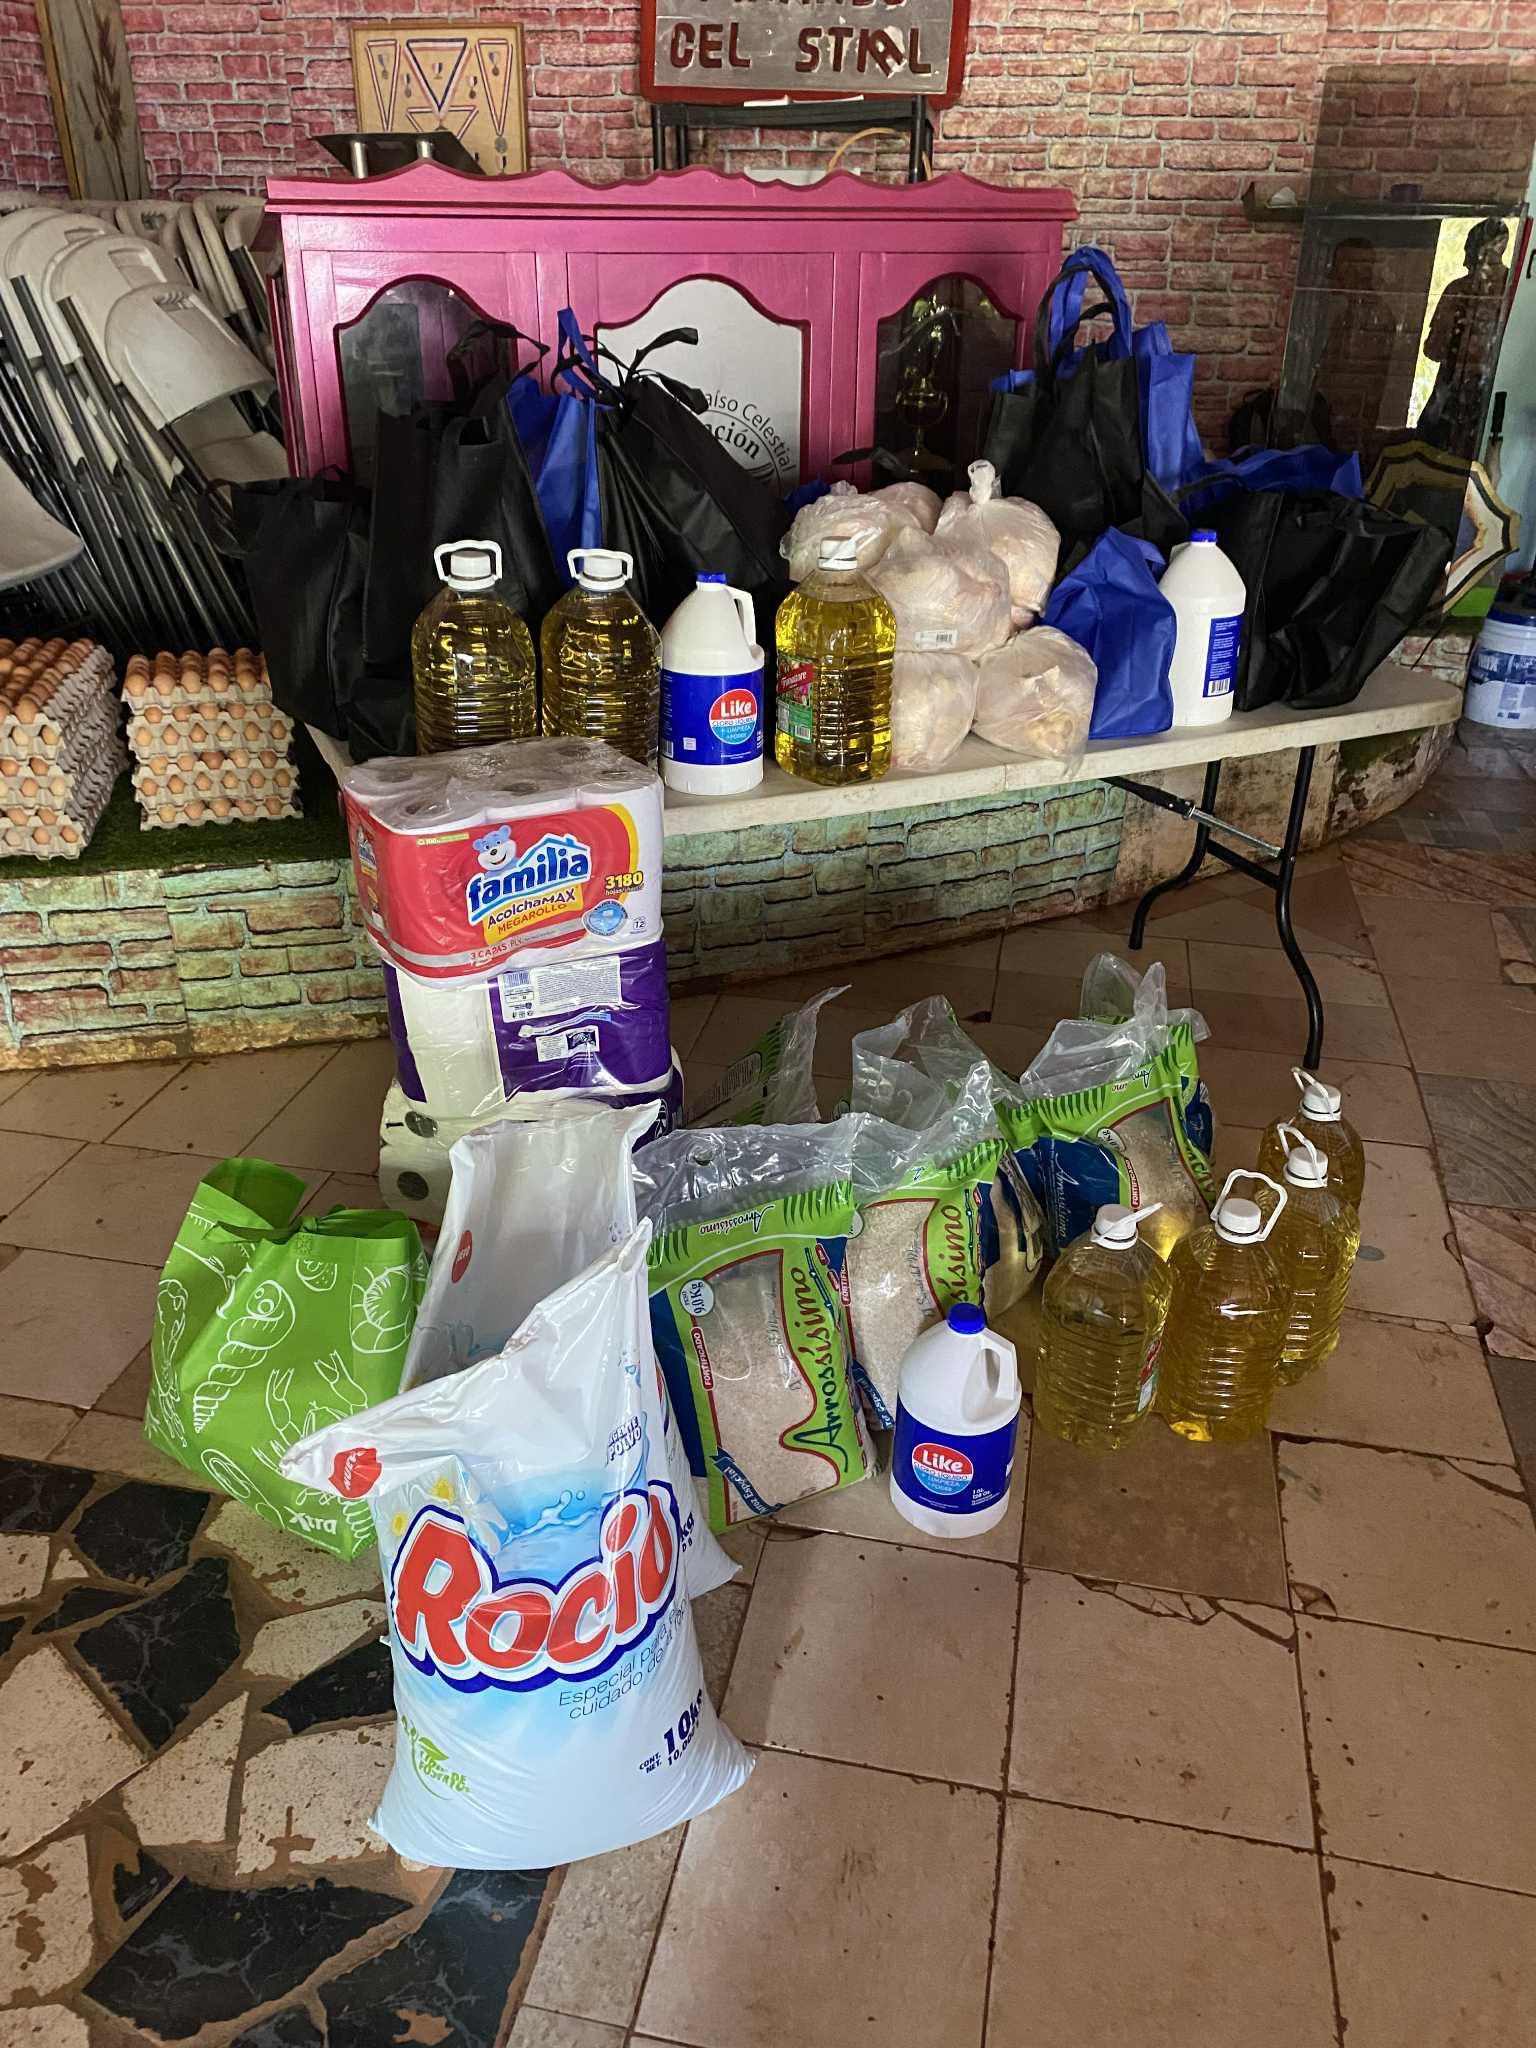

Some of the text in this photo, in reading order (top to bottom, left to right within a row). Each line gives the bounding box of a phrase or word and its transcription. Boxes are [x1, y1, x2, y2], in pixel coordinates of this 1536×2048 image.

[669, 22, 751, 69] CEL
[704, 389, 797, 472] aíso Celestial
[720, 700, 752, 718] Like
[469, 847, 589, 911] familia
[605, 871, 644, 890] 3180
[487, 889, 576, 928] AcolchaMAX
[699, 1204, 776, 1235] Arrossísimo
[936, 1205, 969, 1301] sísimo
[693, 1332, 712, 1387] FORTIFICADO
[791, 1267, 848, 1473] Arrossísimo
[922, 1450, 964, 1473] Like
[725, 1466, 753, 1500] Especial
[283, 1506, 337, 1535] Xtra
[559, 1655, 636, 1707] Especial
[569, 1671, 643, 1720] cuidado
[647, 1647, 665, 1674] de
[639, 1753, 662, 1770] CONT.
[646, 1760, 662, 1774] NET.
